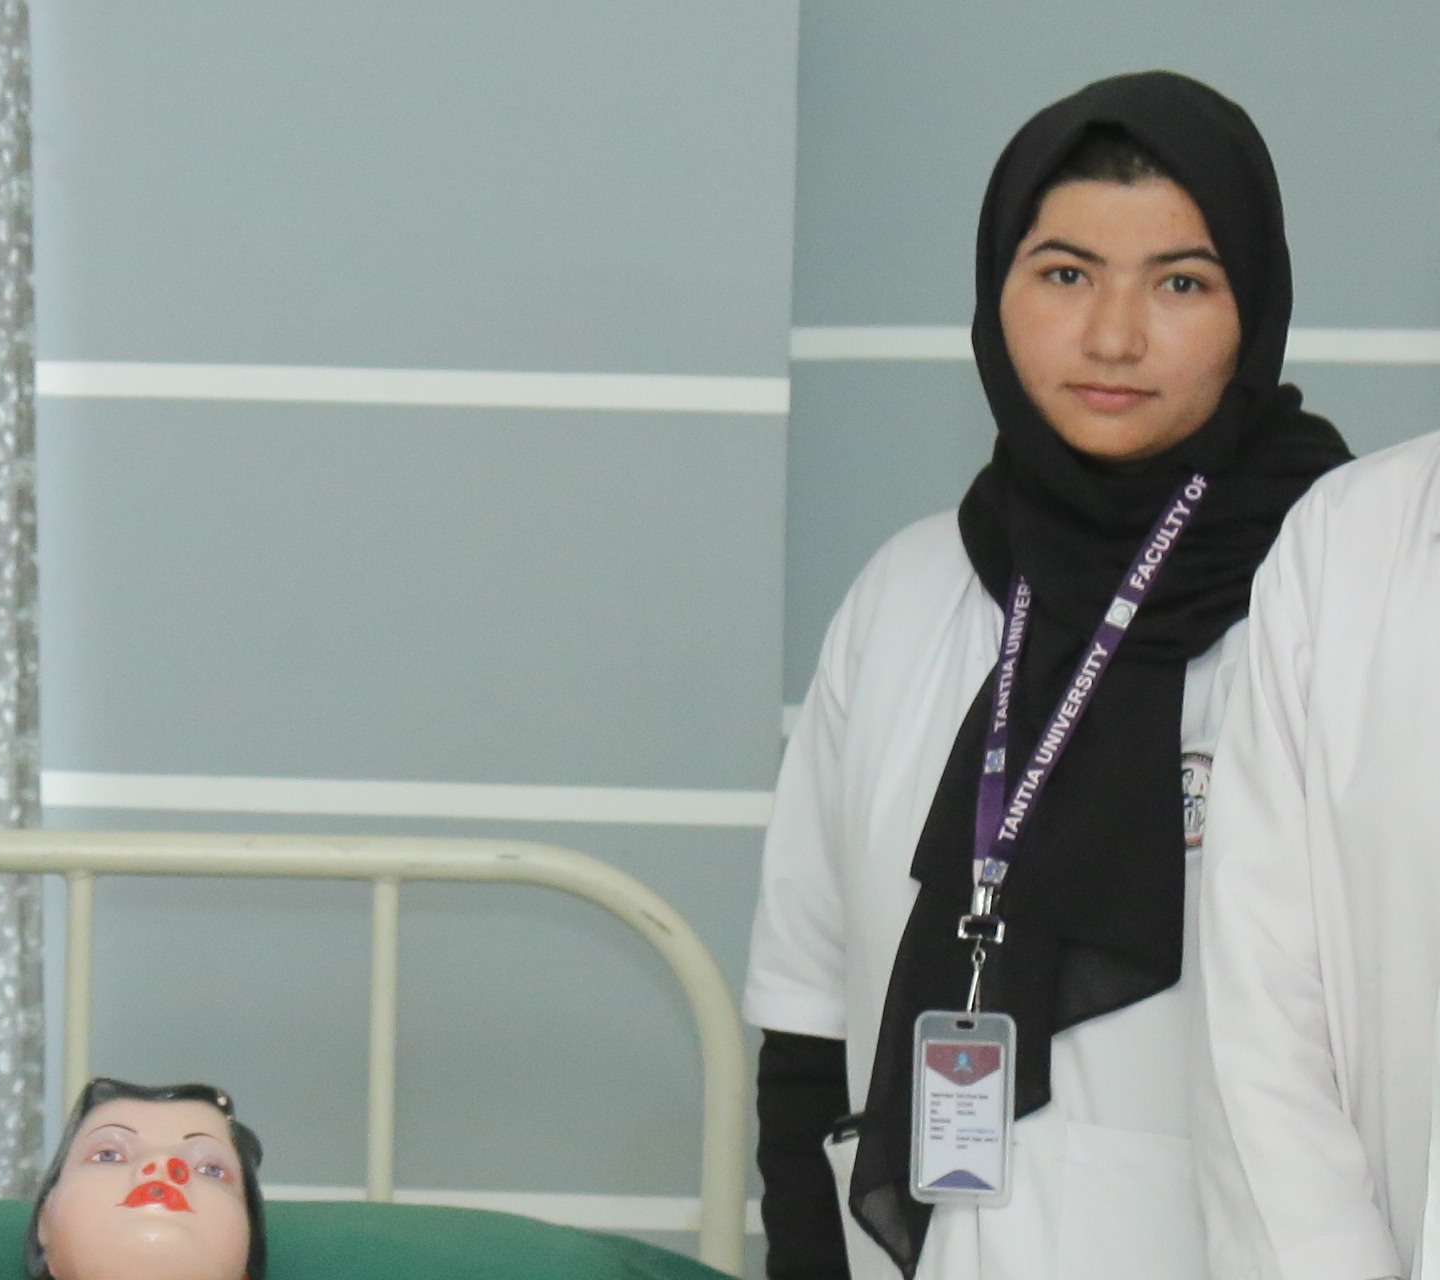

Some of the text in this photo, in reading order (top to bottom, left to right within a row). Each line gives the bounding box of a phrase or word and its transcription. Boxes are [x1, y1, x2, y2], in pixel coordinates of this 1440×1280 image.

[1129, 473, 1208, 591] FACULTY OF
[994, 658, 1016, 733] TANTIA
[998, 642, 1109, 842] TANTIA UNIVERSITY
